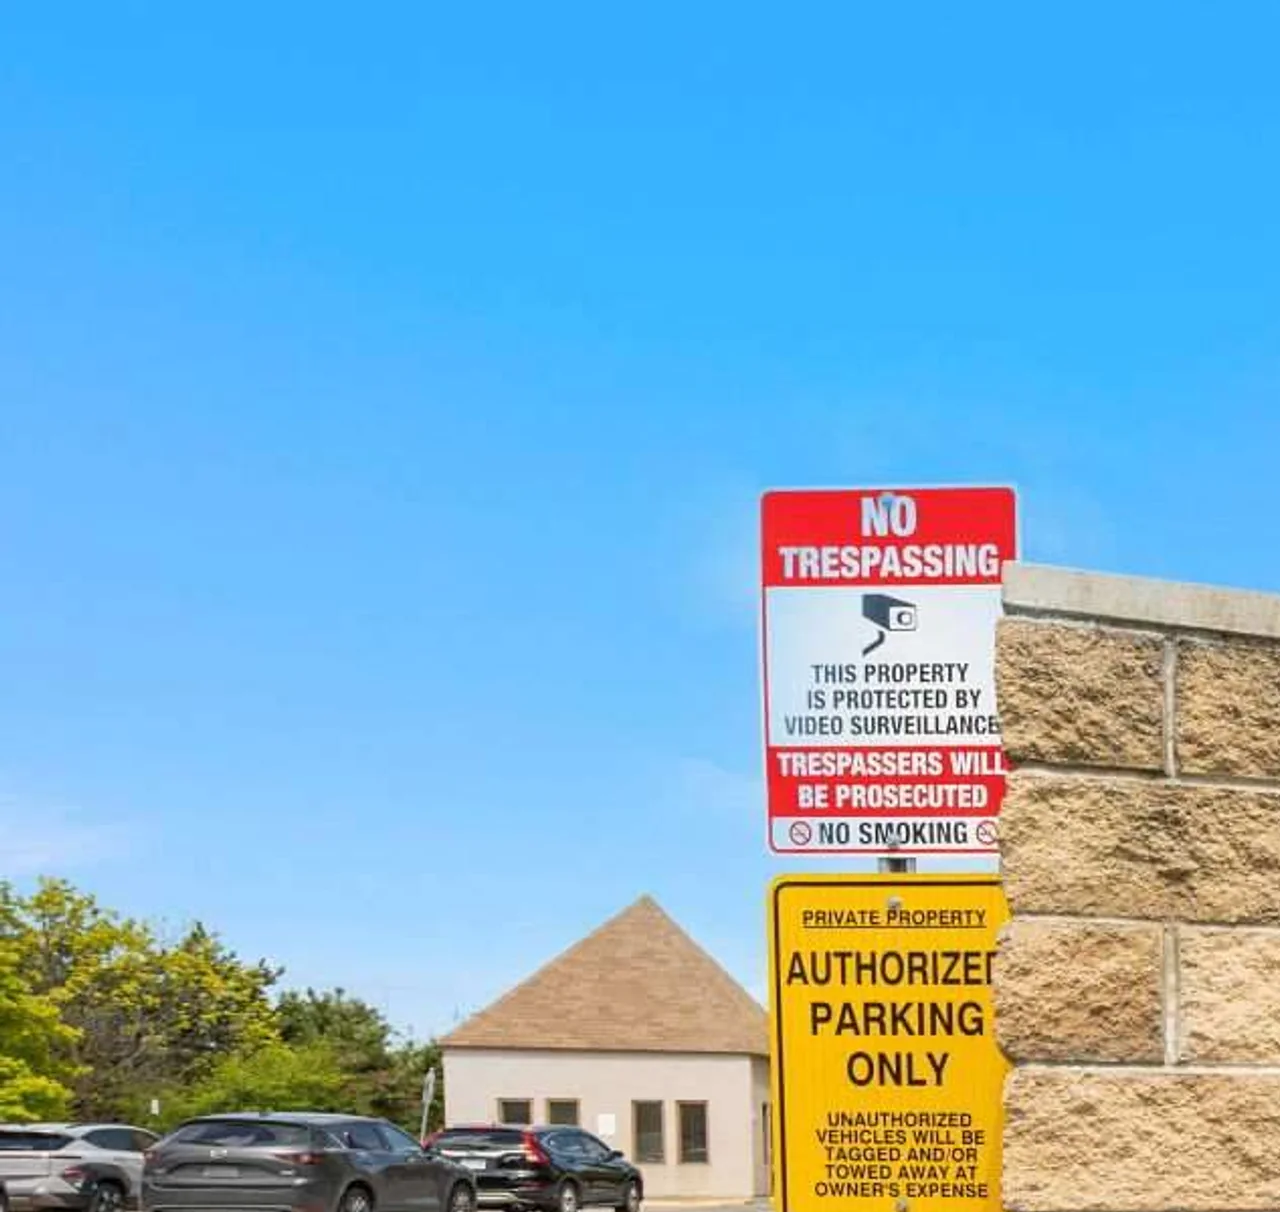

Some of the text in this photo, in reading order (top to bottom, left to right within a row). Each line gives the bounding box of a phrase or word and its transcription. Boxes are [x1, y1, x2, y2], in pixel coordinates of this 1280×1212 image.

[861, 495, 917, 537] NO
[778, 544, 999, 578] TRESPASSING
[811, 663, 969, 684] THIS PROPERTY
[808, 689, 981, 710] IS PROTECTED BY
[785, 715, 1001, 736] VIDEO SURVEILLANCE
[777, 751, 1008, 776] TRESPASSERS WILL
[798, 784, 988, 808] BE PROSECUTED
[818, 823, 967, 844] NO SMOKING
[802, 909, 985, 925] PRIVATE PROPERTY
[811, 1002, 984, 1036] PARKING
[846, 1052, 949, 1086] ONLY
[828, 1113, 972, 1127] UNAUTHORIZED
[816, 1131, 985, 1145] VEHICLES WILL BE
[825, 1148, 978, 1162] TAGGED AND/OR
[825, 1166, 977, 1180] TOWED AWAY AT
[815, 1183, 988, 1198] OWNER'S EXPENSE
